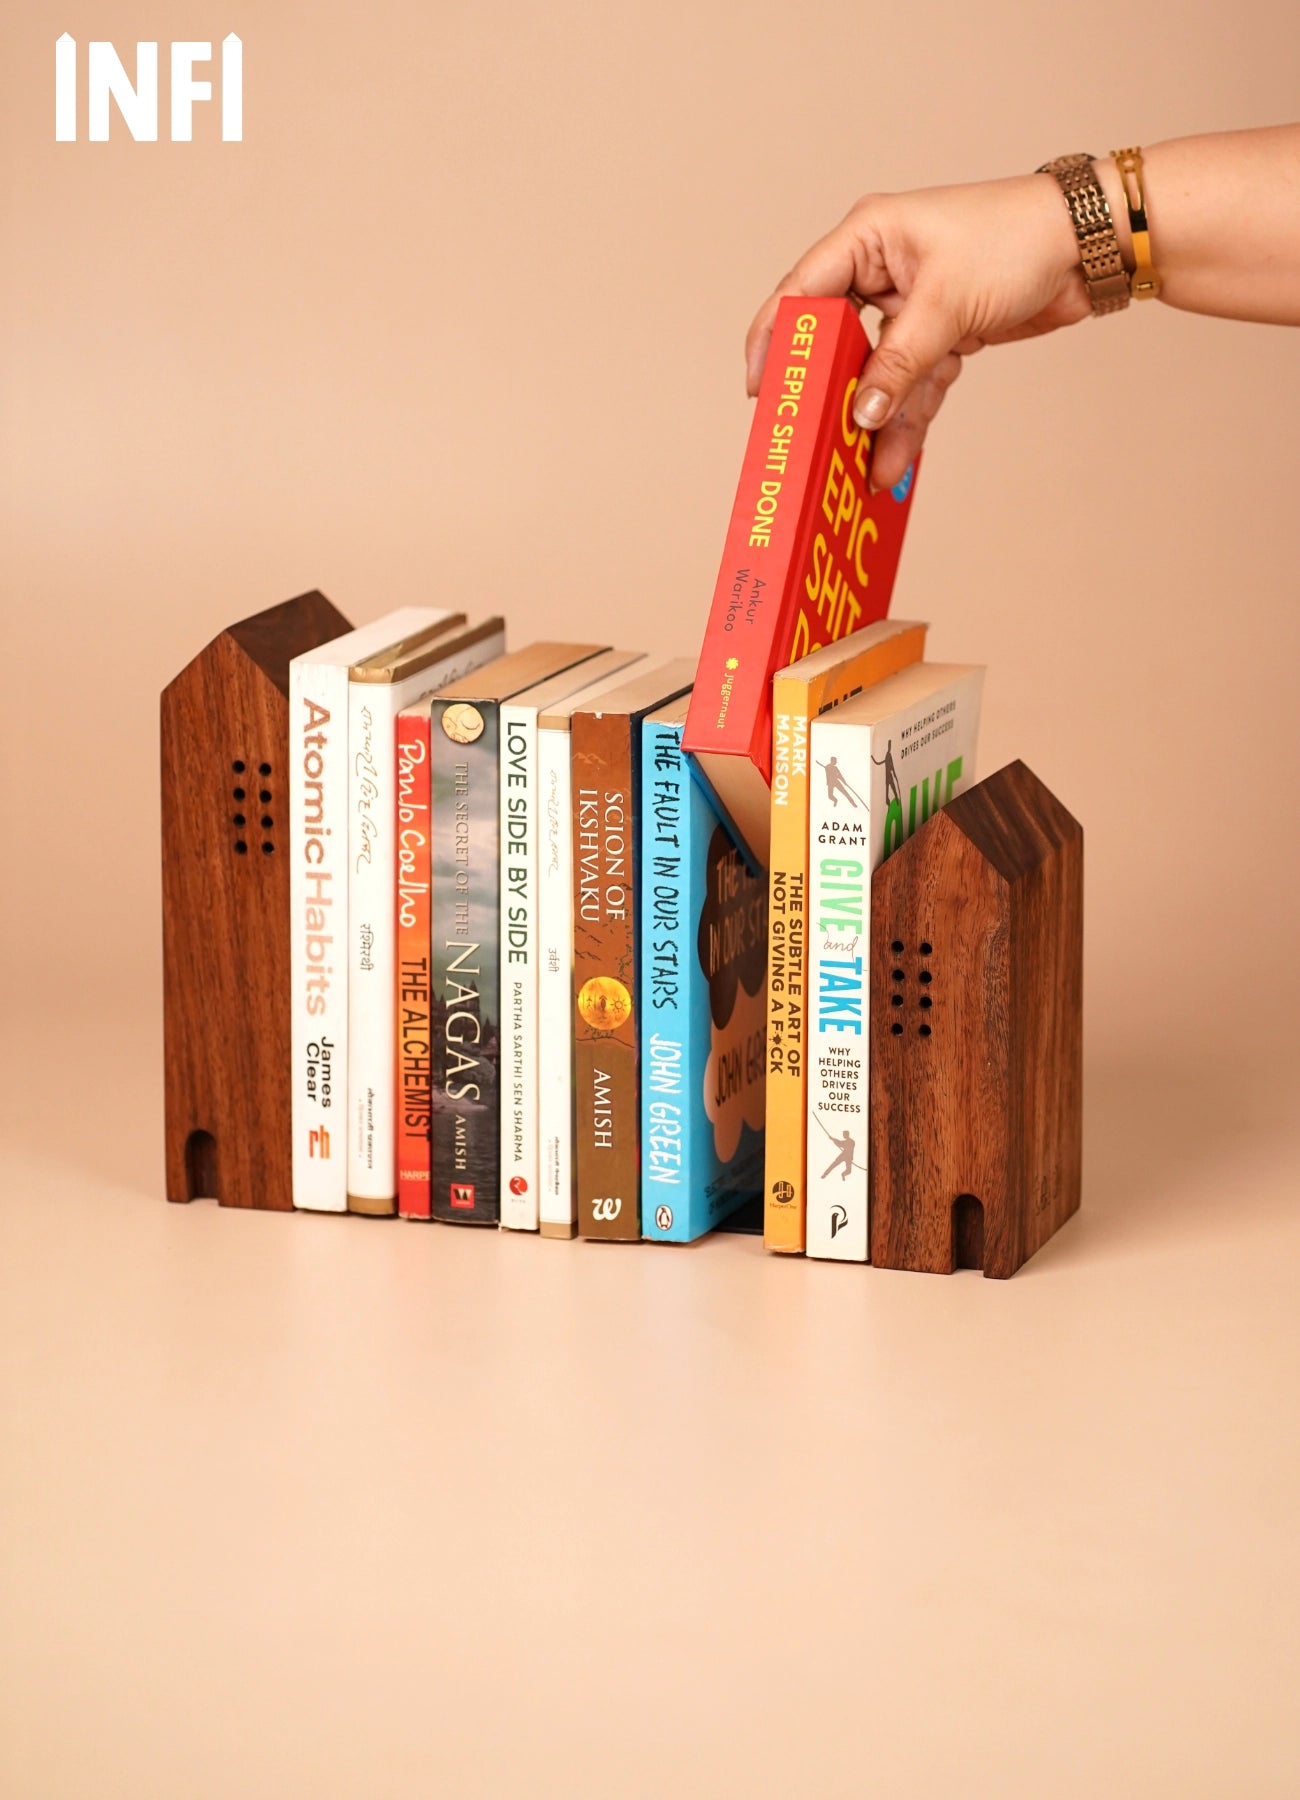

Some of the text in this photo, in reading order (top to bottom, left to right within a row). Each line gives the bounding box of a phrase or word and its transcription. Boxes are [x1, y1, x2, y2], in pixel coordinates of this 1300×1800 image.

[749, 313, 817, 548] GET EPIC SHIT DONE
[822, 448, 878, 587] EPIC
[724, 568, 750, 632] Warikoo
[745, 578, 767, 625] Ankur
[805, 533, 862, 642] SHIT
[793, 715, 807, 777] MARK
[901, 700, 956, 740] WHY HELPING OTHERS
[901, 718, 954, 760] DRIVES OUR SUCCESS
[775, 714, 790, 806] MANSON
[303, 697, 334, 1016] Atomic Habits
[398, 739, 430, 928] Paulo Coelho
[455, 761, 469, 936] THE SECRET OF THE
[507, 722, 528, 964] LOVE SIDE BY SIDE
[579, 788, 600, 922] IKSHVAKU
[604, 791, 626, 921] SCION OF
[818, 835, 867, 847] GRANT
[821, 821, 863, 833] ADAM
[651, 731, 681, 1010] THE FAULT IN OUR STARS
[773, 871, 787, 915] NOT
[819, 858, 864, 935] GIVE
[360, 923, 374, 970] रश्मिरथी
[772, 921, 786, 992] GIVING
[787, 873, 803, 1078] THE SUBTLE ART OF
[823, 935, 858, 953] and
[445, 940, 481, 1102] NAGAS
[771, 998, 784, 1013] A
[819, 957, 862, 1036] TAKE
[306, 1042, 319, 1102] Clear
[321, 1036, 334, 1108] James
[402, 958, 431, 1142] THE ALCHEMIST
[513, 982, 523, 1162] PARTHA SARTHI SEN SHARMA
[714, 1043, 743, 1107] JOHN
[818, 1057, 861, 1069] HELPING
[820, 1068, 859, 1080] OTHERS
[822, 1080, 857, 1091] DRIVES
[828, 1047, 851, 1056] WHY
[593, 1068, 613, 1148] AMISH
[648, 1033, 682, 1185] JOHN GREEN
[818, 1102, 861, 1114] SUCCESS
[828, 1091, 850, 1102] OUR
[455, 1114, 467, 1170] AMISH
